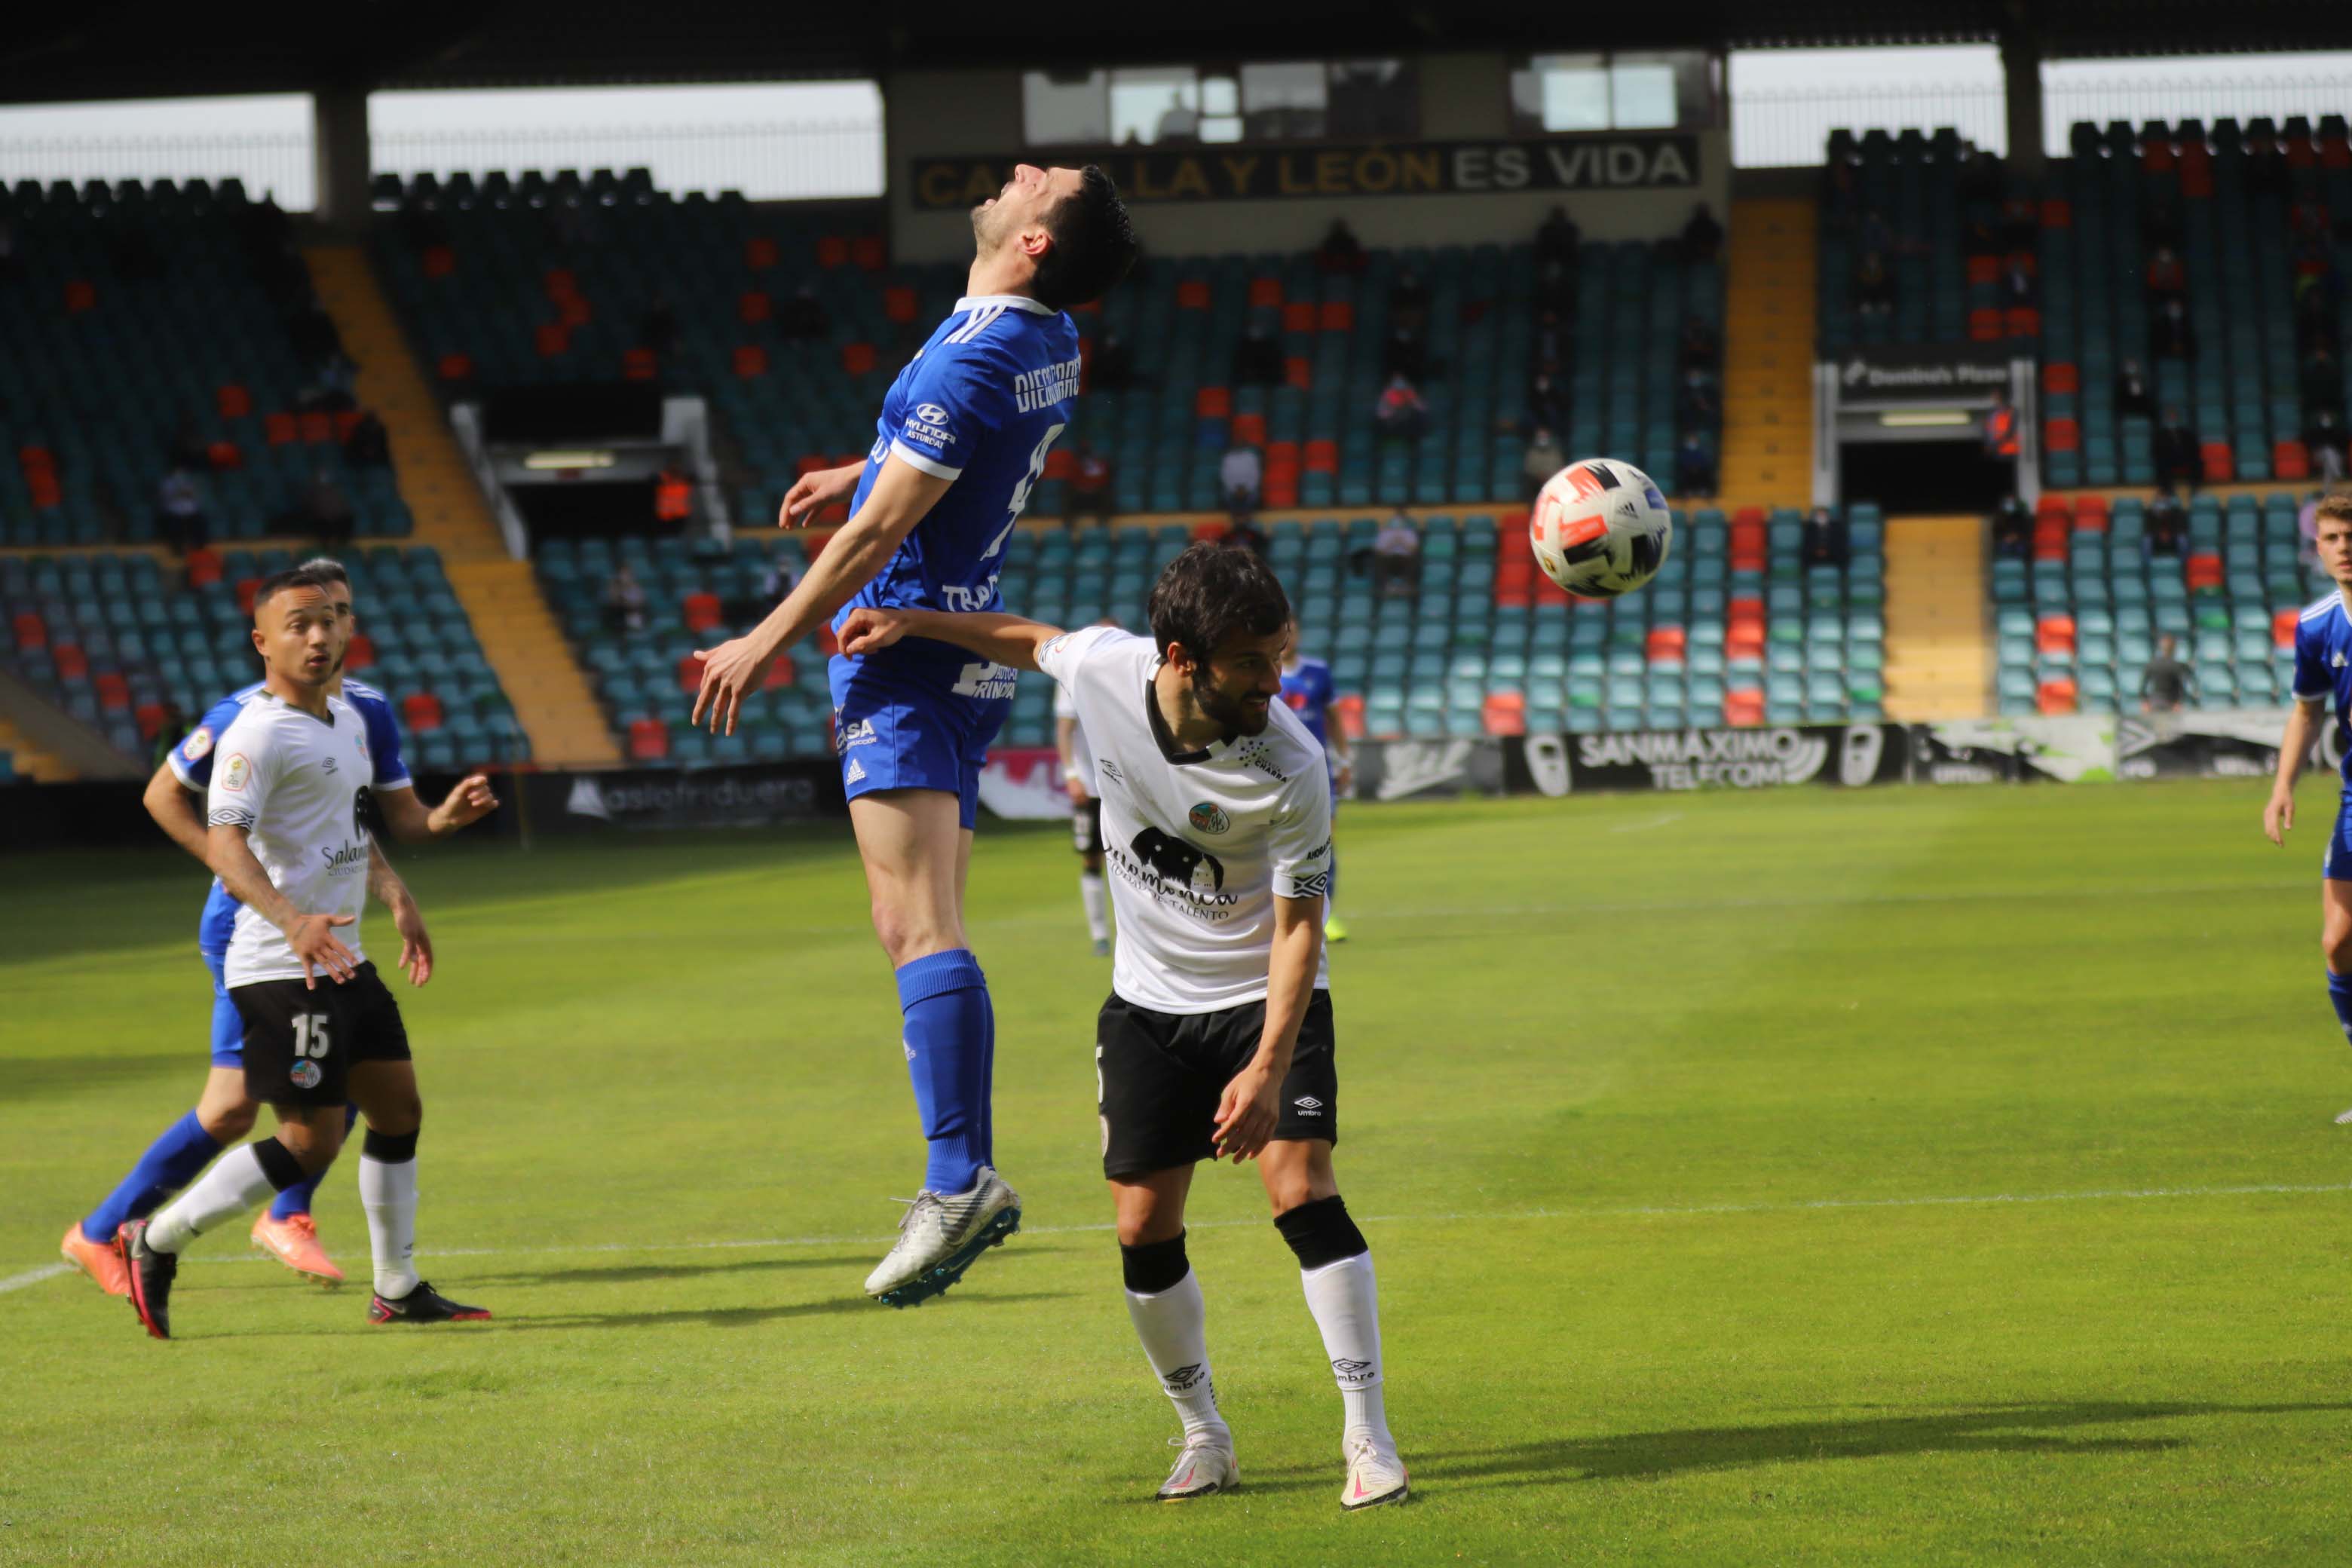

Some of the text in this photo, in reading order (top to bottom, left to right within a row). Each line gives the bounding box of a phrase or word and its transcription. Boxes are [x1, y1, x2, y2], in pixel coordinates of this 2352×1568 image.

[1220, 153, 1260, 195] Y
[1454, 147, 1533, 188] ES
[1546, 142, 1692, 185] VIDA
[905, 417, 957, 446] HYUNDAI
[1254, 759, 1288, 783] CHARRA
[1650, 762, 1783, 789] TELECOM
[1169, 899, 1230, 920] TALENTO
[291, 1013, 329, 1058] 15
